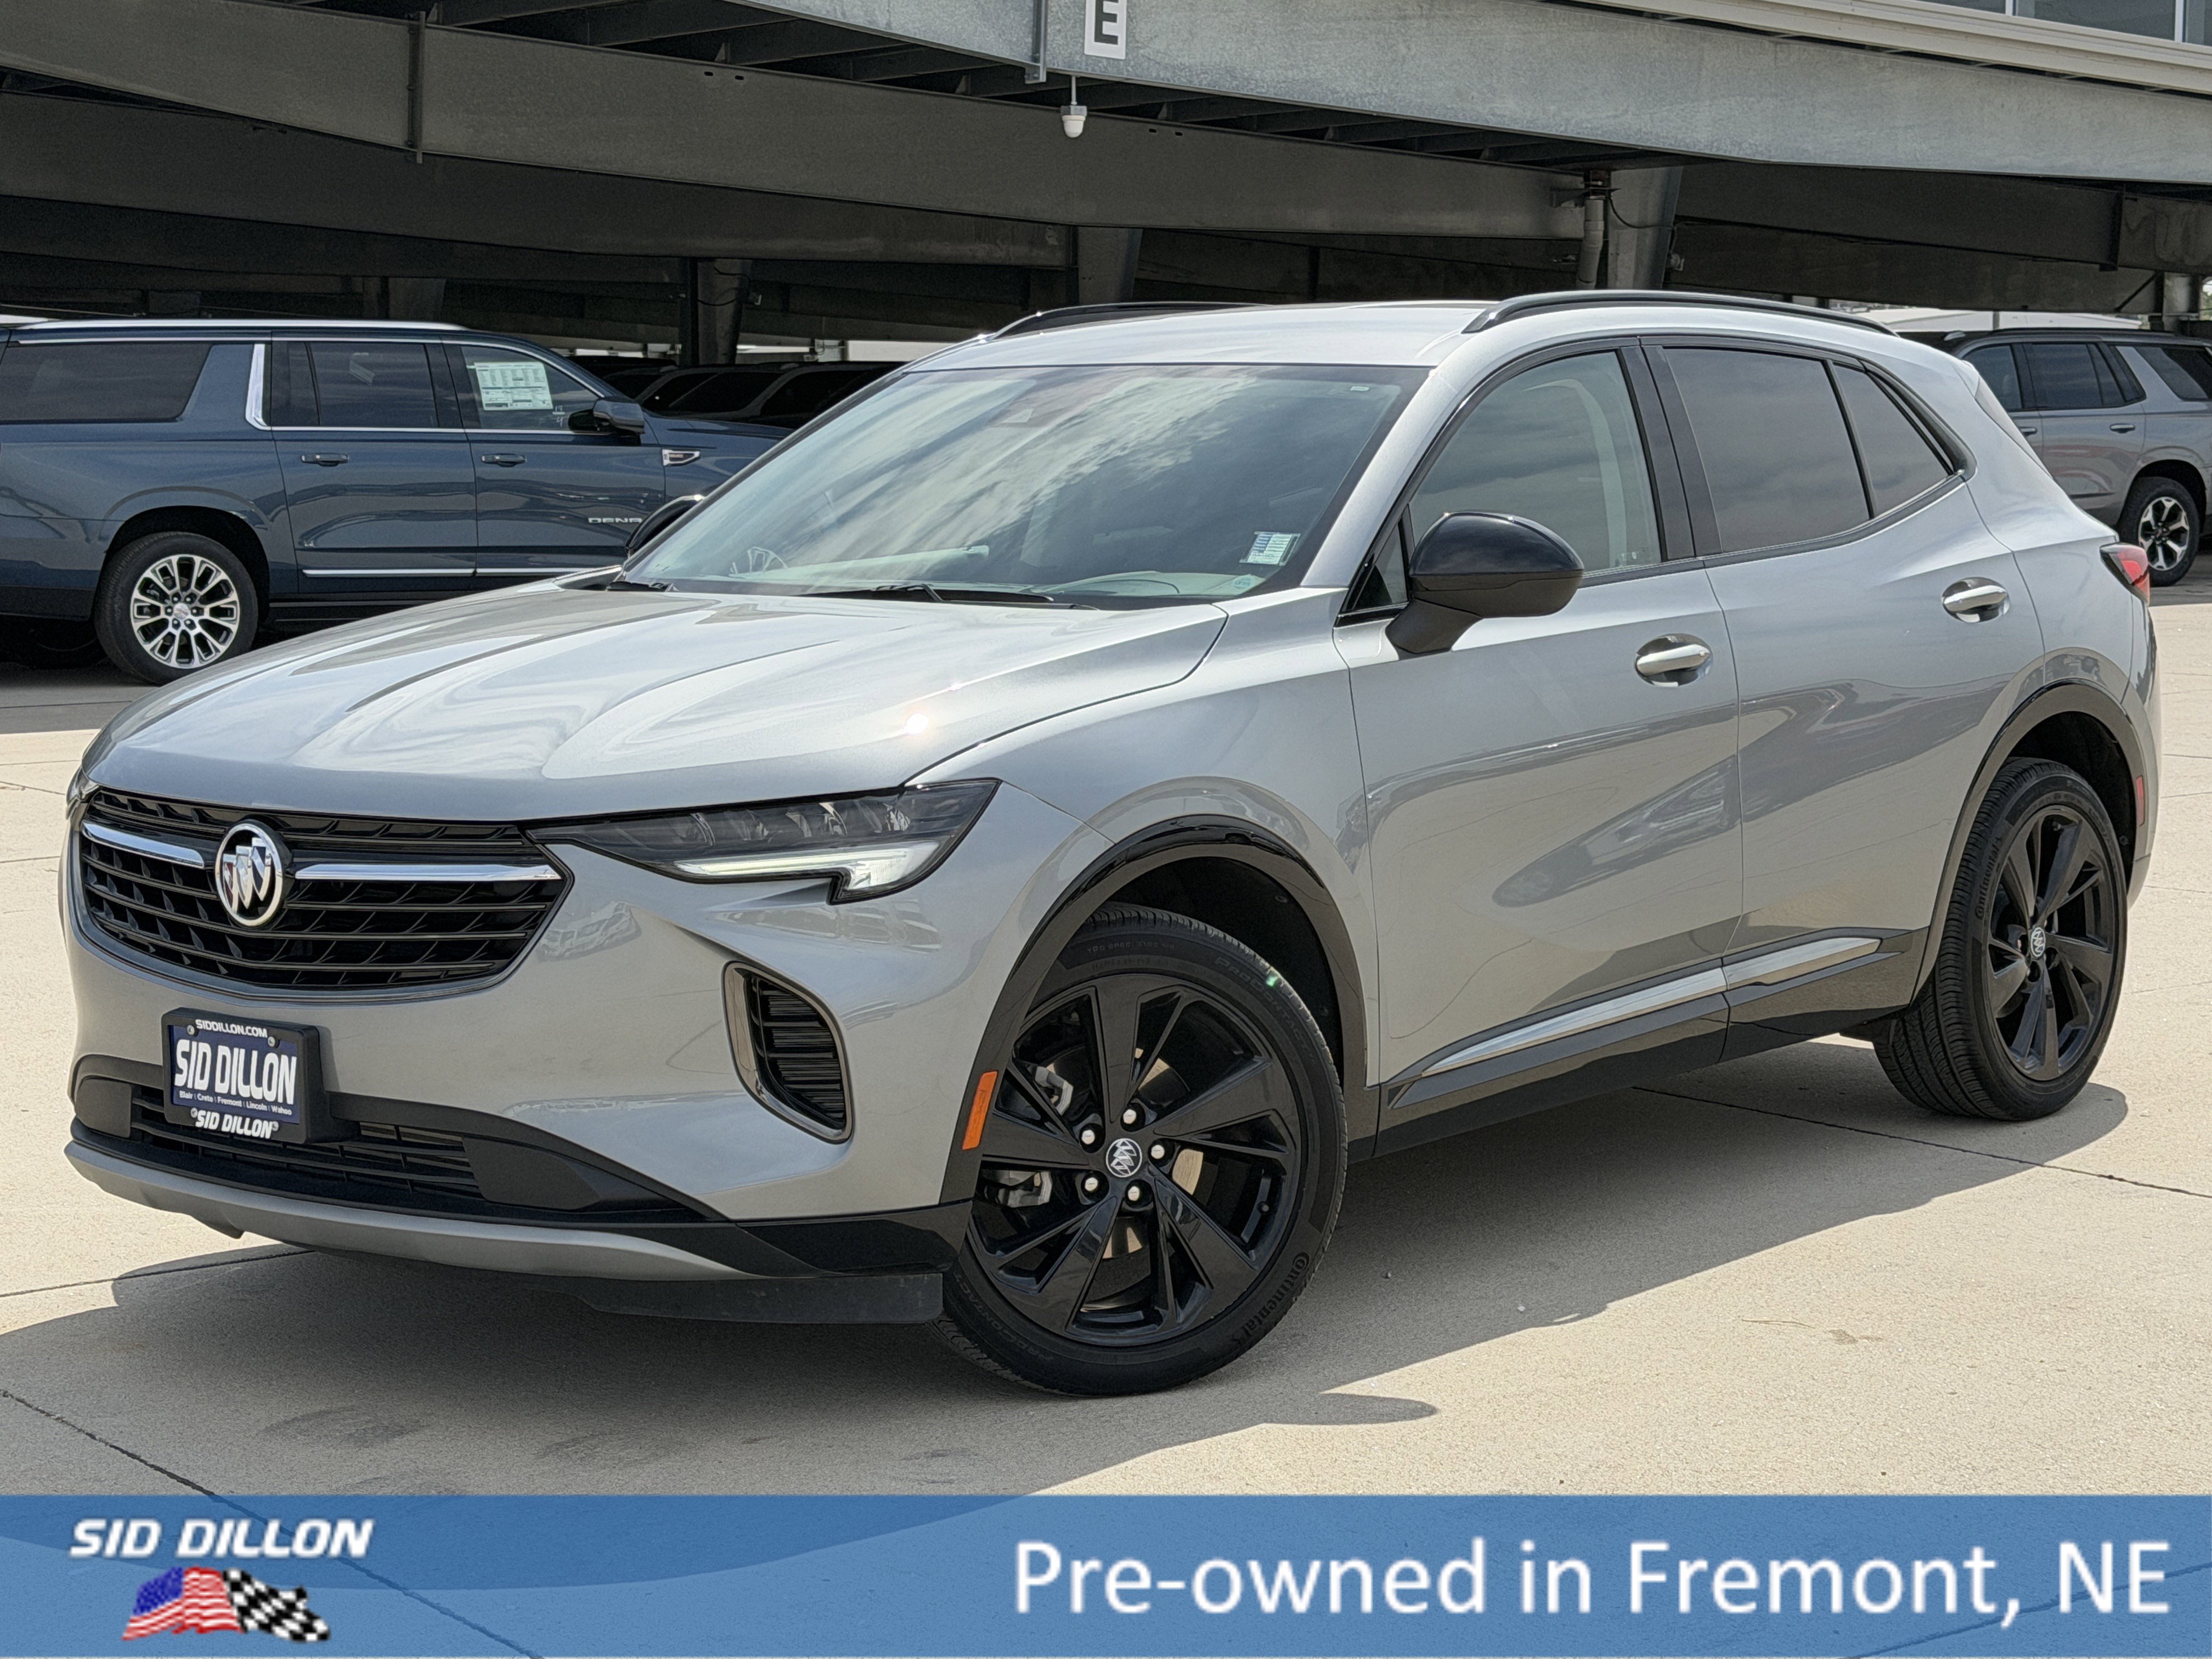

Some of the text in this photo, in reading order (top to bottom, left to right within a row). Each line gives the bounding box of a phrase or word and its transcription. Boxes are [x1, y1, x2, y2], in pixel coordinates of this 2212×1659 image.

[1094, 0, 1119, 45] E
[1975, 844, 1999, 920] Continental
[195, 1019, 268, 1038] SIDDILLON.COM
[174, 1040, 297, 1105] SID DILLON
[195, 1110, 273, 1139] SID DILLON
[218, 1097, 242, 1107] Fremont
[246, 1101, 268, 1111] Lincoln
[271, 1105, 292, 1115] Wahoo
[1242, 1251, 1310, 1337] Continental
